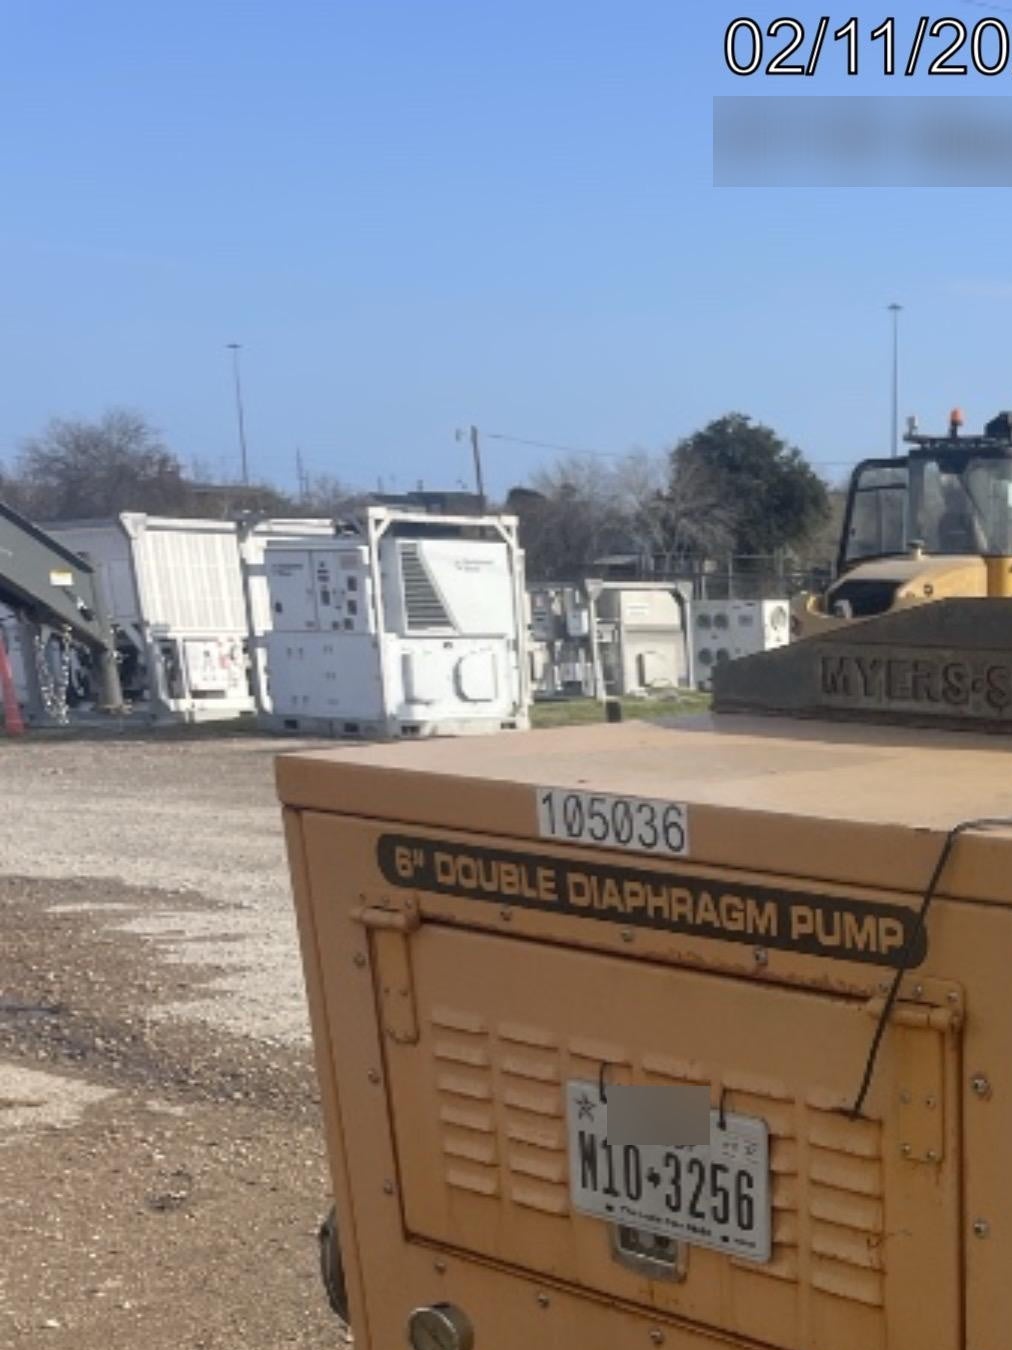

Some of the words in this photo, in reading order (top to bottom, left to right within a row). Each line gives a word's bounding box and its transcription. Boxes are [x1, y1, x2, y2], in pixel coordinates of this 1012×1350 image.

[541, 792, 687, 853] 105036
[394, 845, 425, 878] 6"
[434, 853, 558, 902] DOUBLE
[566, 871, 780, 937] DIAPHRAGM
[790, 907, 905, 954] PUMP
